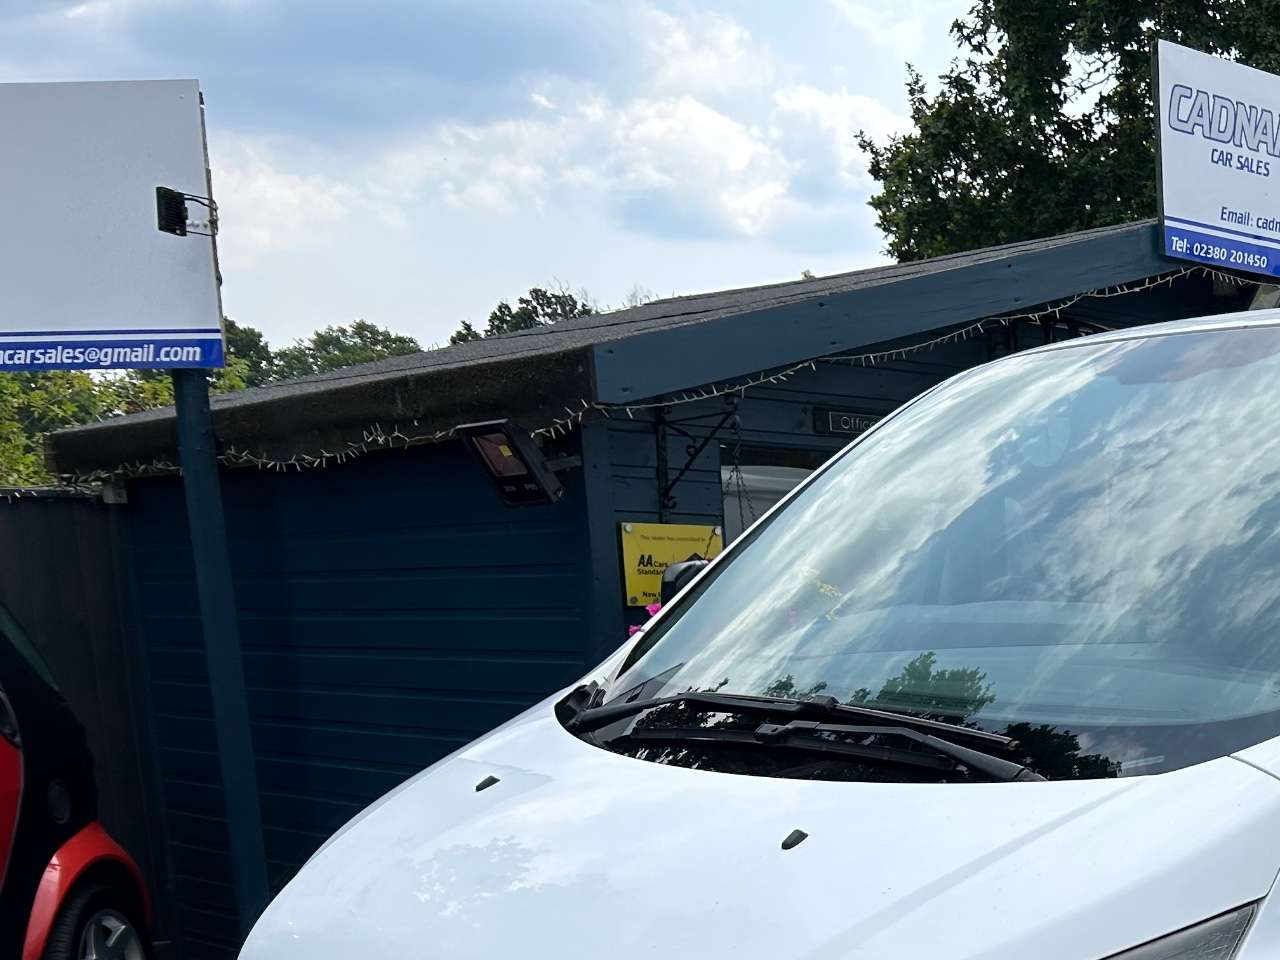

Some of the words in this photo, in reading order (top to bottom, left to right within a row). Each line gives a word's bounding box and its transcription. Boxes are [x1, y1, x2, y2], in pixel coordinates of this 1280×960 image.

[1211, 148, 1233, 168] CAR
[1236, 155, 1270, 177] SALES
[1220, 206, 1254, 228] Email:
[1171, 236, 1191, 254] Tel:
[1193, 242, 1227, 261] 02380
[1230, 250, 1268, 268] 201450
[637, 554, 653, 567] AA
